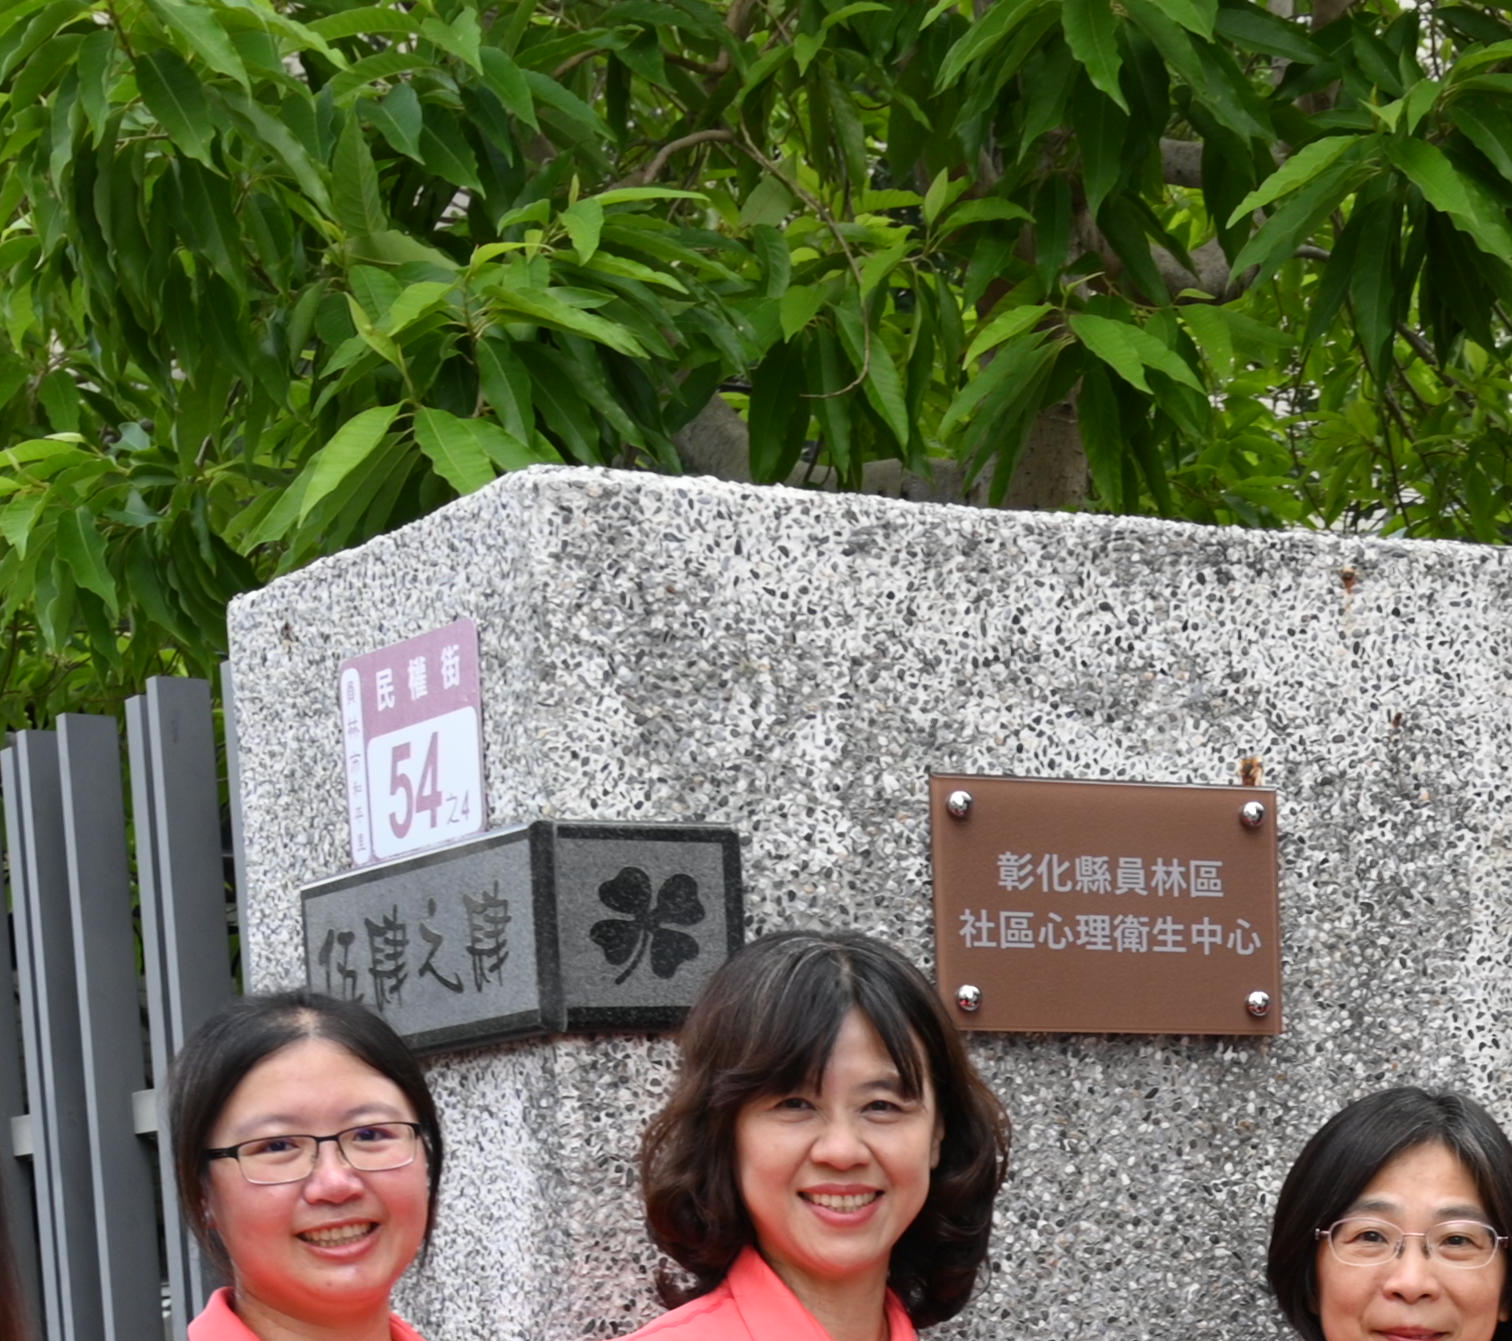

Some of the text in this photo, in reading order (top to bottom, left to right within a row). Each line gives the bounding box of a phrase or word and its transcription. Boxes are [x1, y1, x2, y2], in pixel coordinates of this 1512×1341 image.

[389, 730, 443, 850] 54
[996, 850, 1225, 898] 彰化縣員林區
[958, 907, 1262, 956] 社區心理衛生中心
